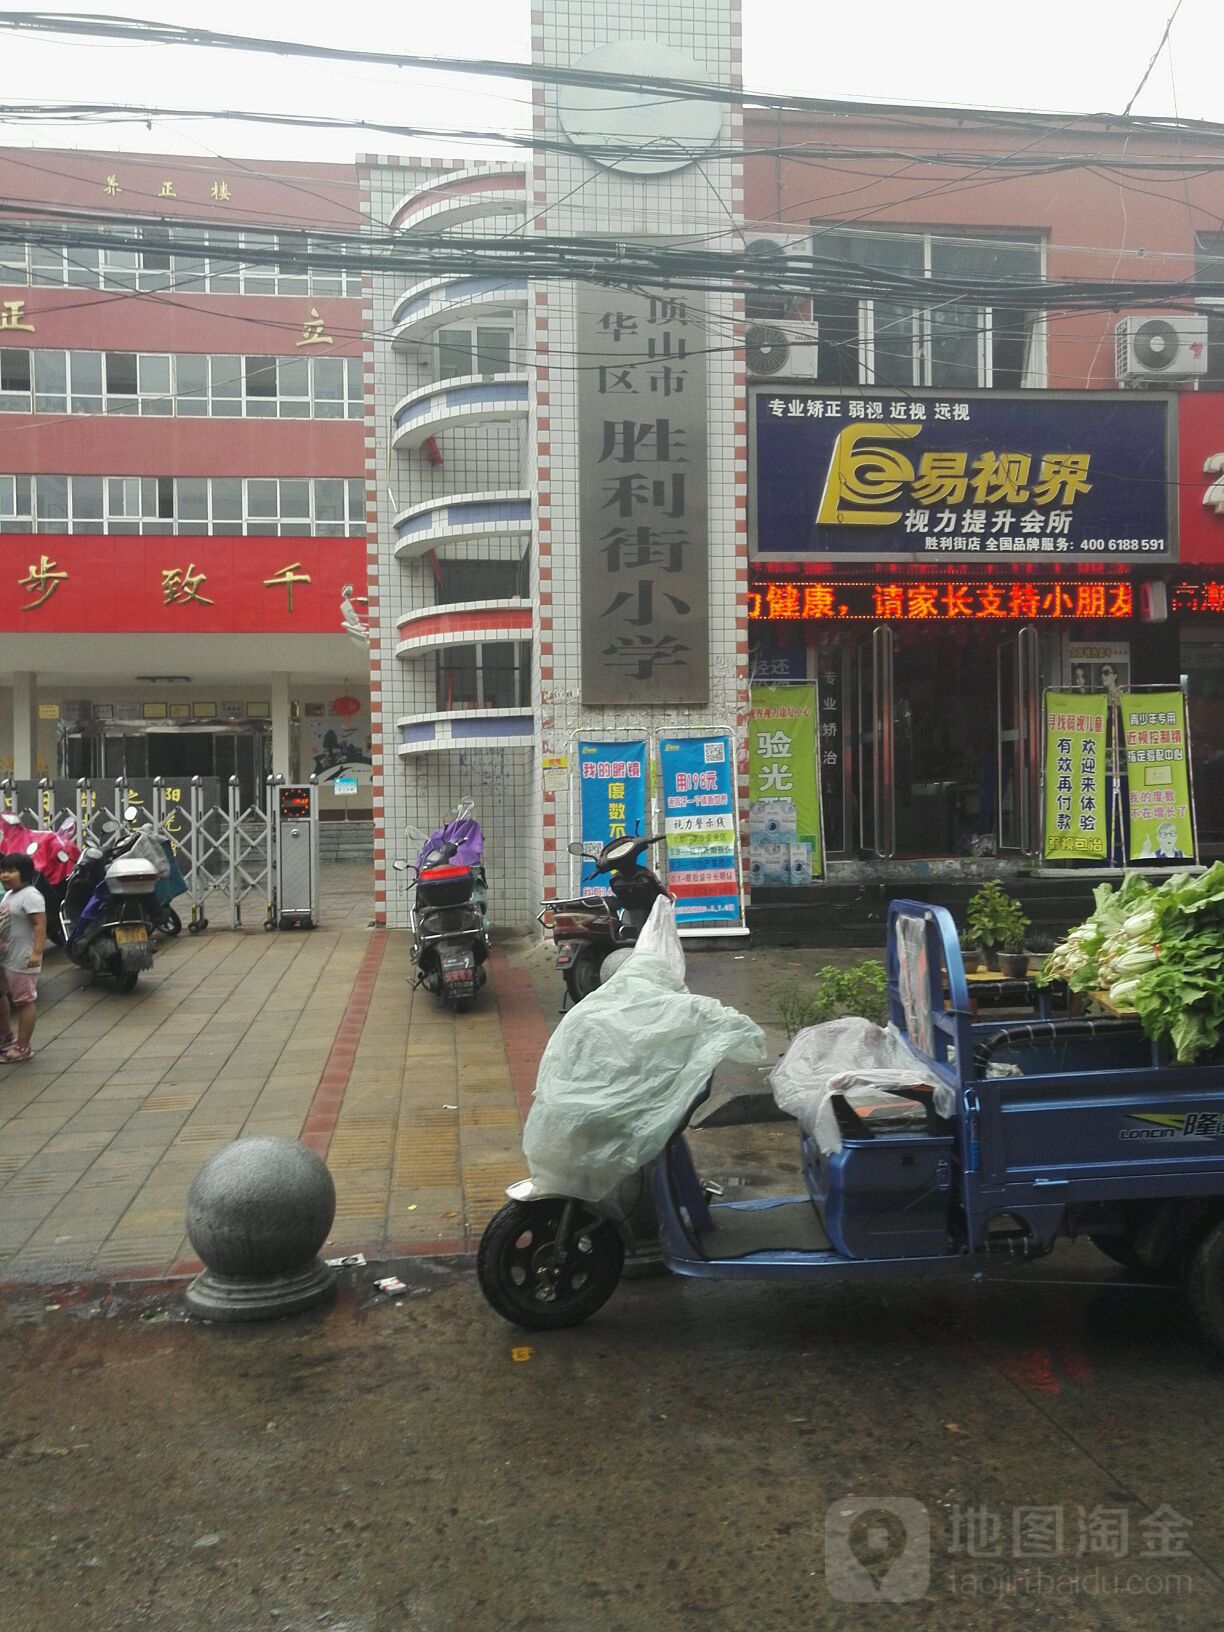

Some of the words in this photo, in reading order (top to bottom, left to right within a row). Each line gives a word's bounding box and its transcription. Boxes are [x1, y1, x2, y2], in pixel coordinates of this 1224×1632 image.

[0, 300, 36, 334] 正
[295, 307, 334, 347] 立
[646, 280, 688, 396] 顶山市
[768, 399, 842, 418] 专业矫正
[848, 401, 884, 419] 弱视
[889, 402, 927, 420] 近视
[933, 403, 971, 421] 远视
[909, 452, 1094, 506] 易视界
[904, 508, 1073, 535] 视力提升会所
[924, 536, 981, 552] 胜利街店
[985, 537, 1075, 553] 全国品牌服务:
[1080, 538, 1105, 551] 400
[1108, 538, 1139, 551] 6188
[1141, 538, 1165, 551] 591
[597, 418, 692, 680] 胜利街小学
[823, 671, 838, 766] 专业矫治
[1130, 712, 1176, 725] 青少年专用
[582, 761, 641, 779] 我的眼镜
[757, 730, 793, 803] 验光
[1057, 738, 1072, 830] 有效再付款
[1080, 739, 1096, 830] 欢迎来体验
[1183, 1111, 1224, 1137] 隆
